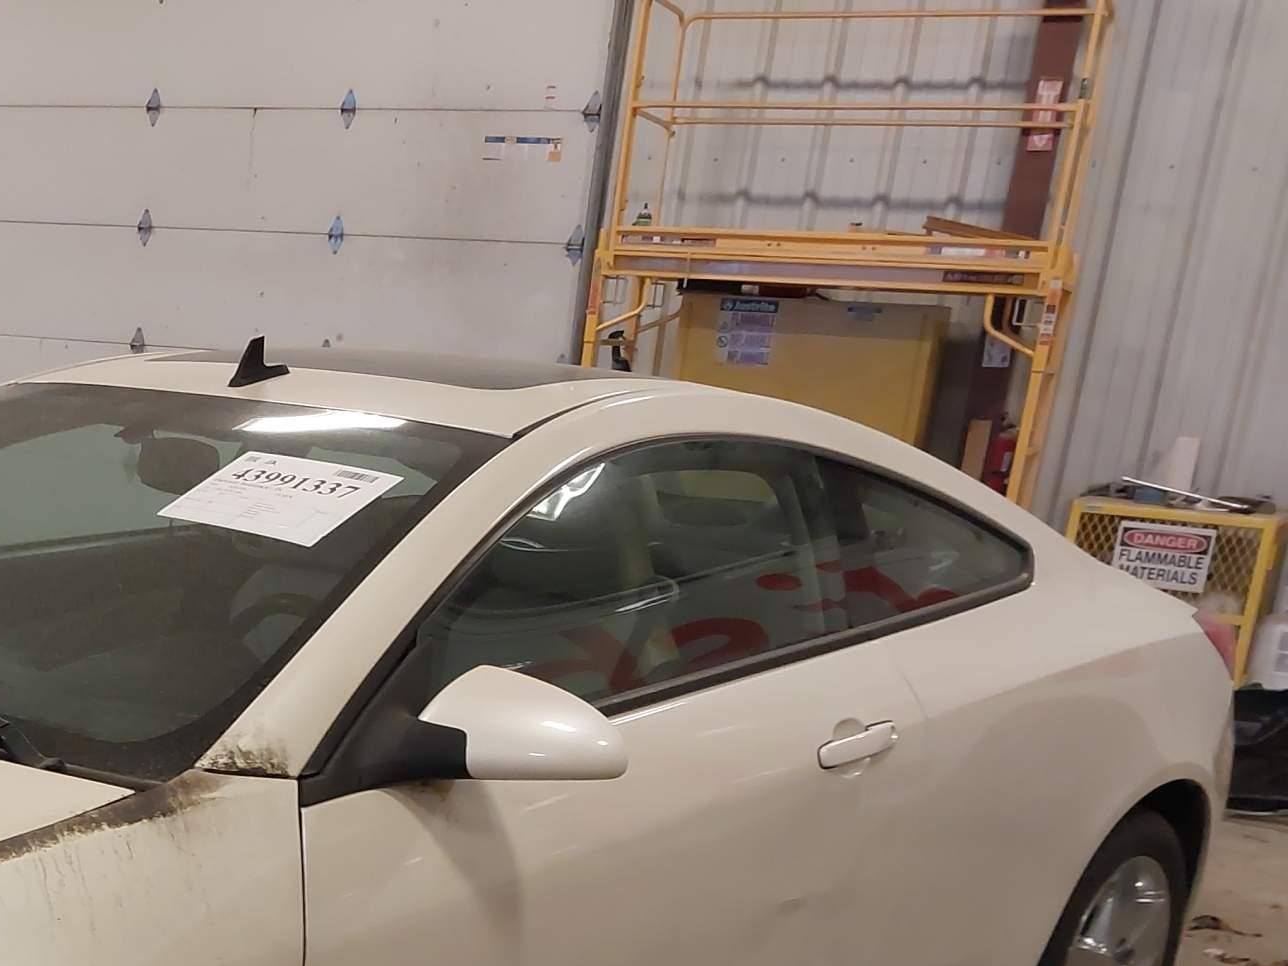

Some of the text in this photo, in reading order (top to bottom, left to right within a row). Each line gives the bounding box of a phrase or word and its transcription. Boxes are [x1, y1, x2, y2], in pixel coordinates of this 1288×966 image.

[232, 467, 360, 499] 43991337
[1133, 533, 1198, 549] DANGER
[1119, 549, 1205, 570] FLAMMABLE
